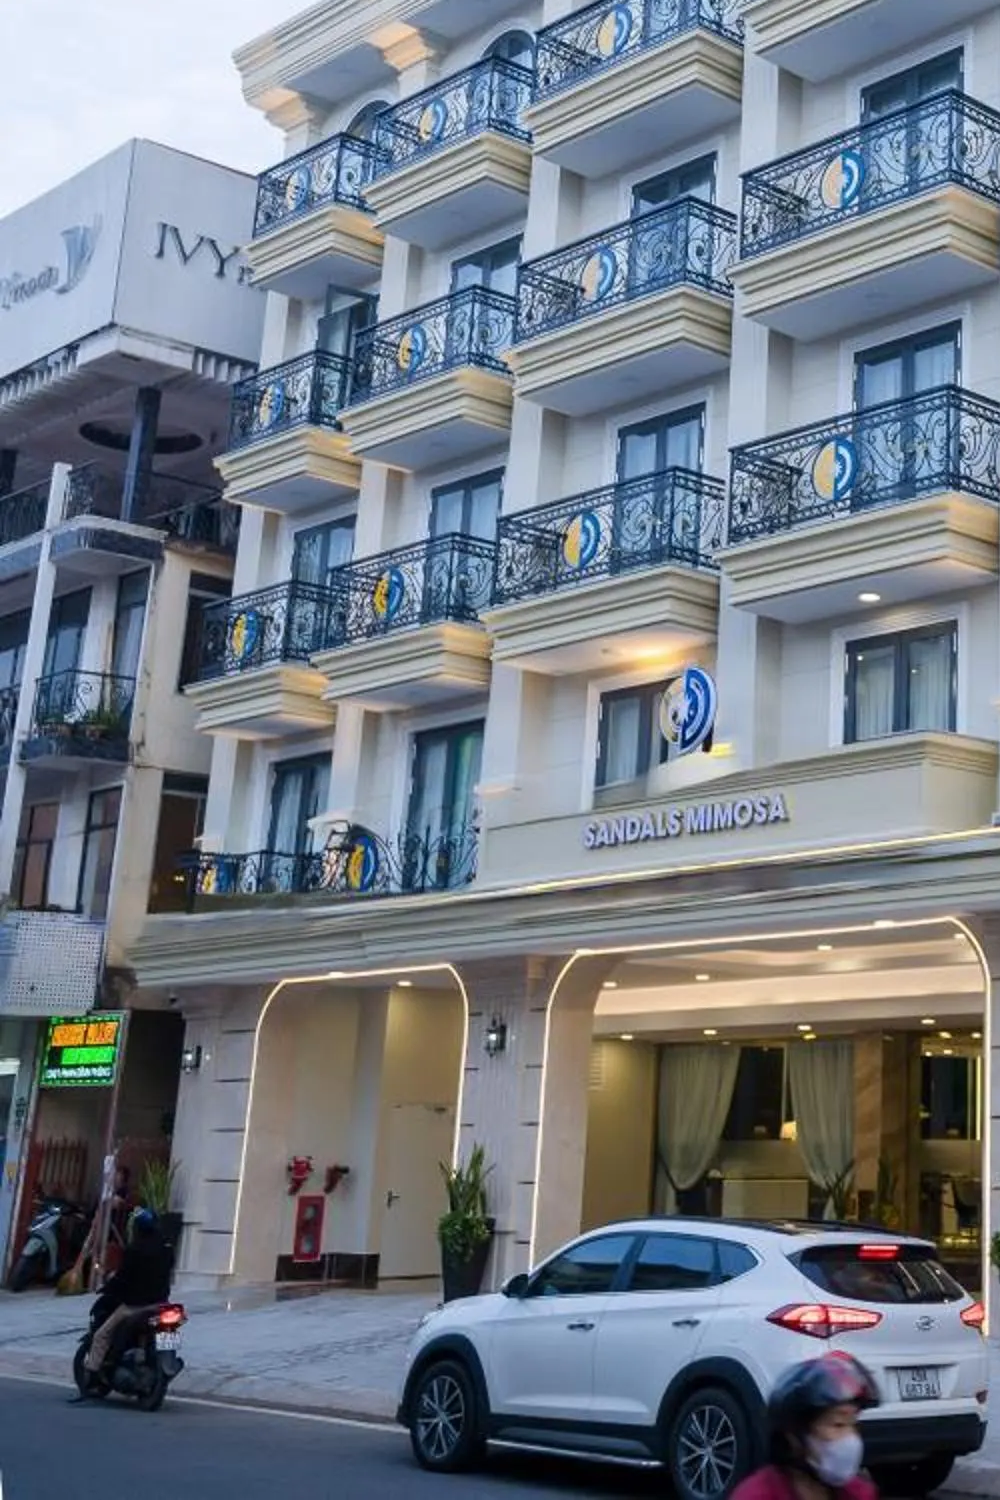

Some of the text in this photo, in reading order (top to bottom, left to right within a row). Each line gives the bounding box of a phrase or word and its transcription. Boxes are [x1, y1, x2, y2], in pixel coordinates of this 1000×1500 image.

[155, 222, 241, 279] IVY
[582, 793, 789, 849] SANDALS MIMOSA
